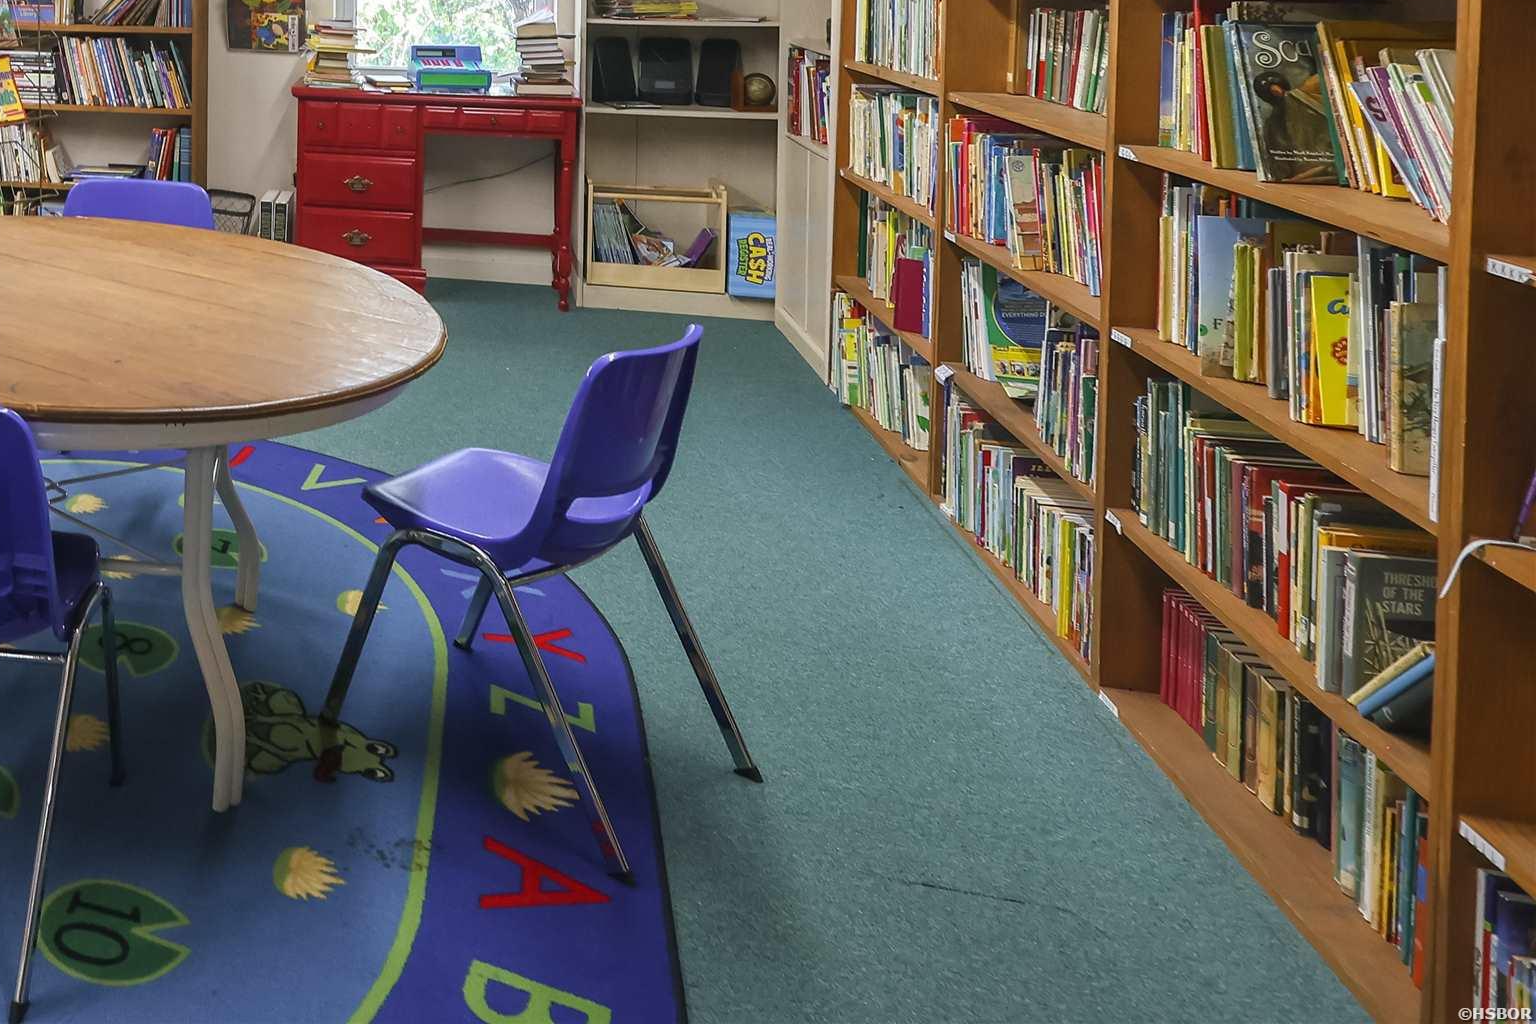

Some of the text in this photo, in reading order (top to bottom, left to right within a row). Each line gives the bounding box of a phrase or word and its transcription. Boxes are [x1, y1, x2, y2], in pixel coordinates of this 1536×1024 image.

[737, 239, 748, 276] REGISTER
[746, 233, 767, 284] CASH
[1002, 311, 1039, 319] EVERYTHING
[1431, 416, 1439, 439] Hungry
[300, 463, 367, 492] V
[1382, 600, 1422, 616] STARS
[1383, 587, 1424, 601] OF THE
[100, 631, 154, 658] 8
[482, 627, 588, 664] Y
[489, 683, 597, 734] Z
[479, 835, 612, 910] A
[53, 892, 142, 966] 10
